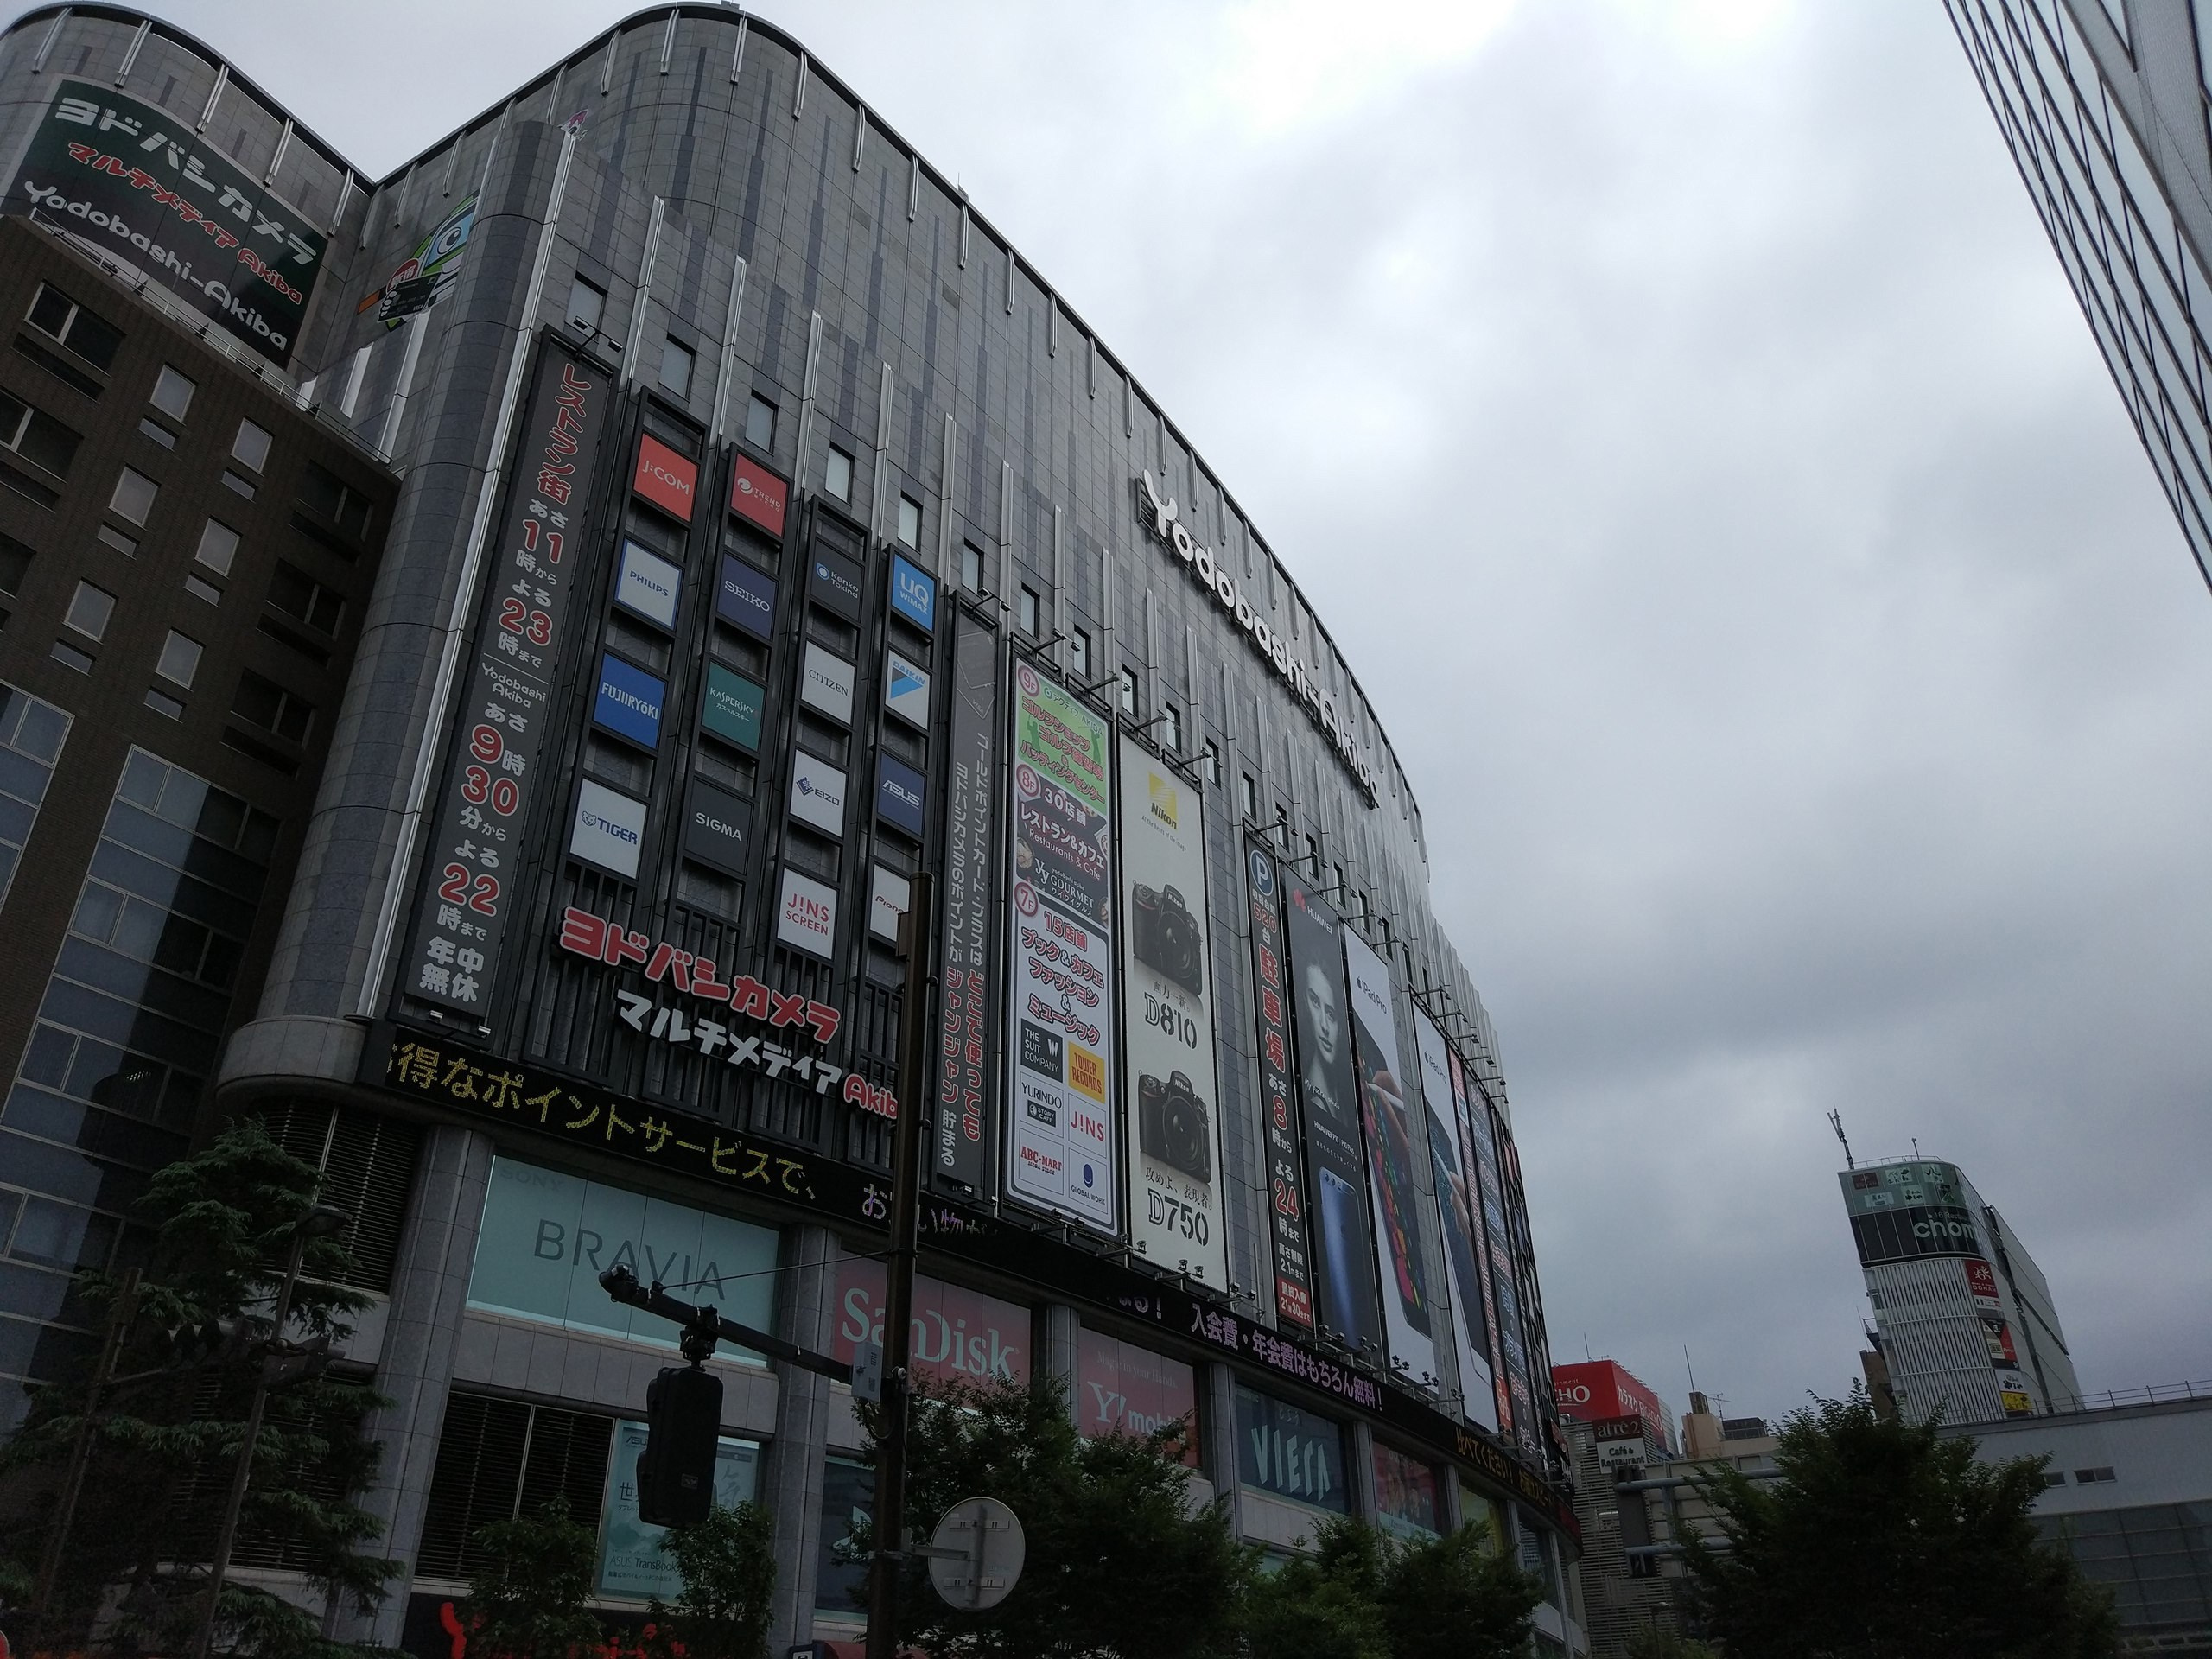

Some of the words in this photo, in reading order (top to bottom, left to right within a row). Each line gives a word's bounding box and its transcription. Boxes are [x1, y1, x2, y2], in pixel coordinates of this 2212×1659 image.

[55, 98, 316, 265] ヨドバシカメラ
[68, 142, 239, 249] マルチメディア
[238, 247, 302, 305] Akiba
[24, 180, 288, 352] Yodobashi-Akiba
[537, 363, 592, 505] レストラン街
[642, 459, 690, 496] J:COM
[754, 486, 781, 510] TREND
[529, 499, 569, 529] あさ
[522, 518, 563, 564] 11
[516, 549, 557, 585] 時から
[830, 570, 859, 594] Kenko
[512, 578, 552, 607] よる
[629, 570, 669, 598] PHILIPS
[724, 580, 770, 613] SEIKO
[830, 578, 859, 599] Tokina
[899, 572, 930, 602] UQ
[499, 597, 553, 646] 23
[498, 631, 543, 669] 時まで
[481, 662, 546, 703] Yodobashi
[809, 669, 849, 697] CITIZEN
[893, 660, 925, 686] DAIKIN
[492, 682, 531, 709] Akiba
[484, 702, 529, 733] あさ
[461, 765, 519, 817] 30
[814, 788, 840, 807] EIZO
[882, 779, 920, 807] ASUS
[459, 805, 506, 842] 分から
[696, 812, 742, 842] SIGMA
[1151, 802, 1177, 830] Nikon
[598, 817, 638, 846] TIGER
[1029, 830, 1074, 863] Restaurants
[454, 840, 499, 868] よる
[1255, 855, 1268, 887] P
[438, 862, 501, 918] 22
[875, 895, 906, 914] Pione
[1051, 875, 1095, 909] GOURMET
[1168, 893, 1183, 909] Nikon
[437, 904, 487, 942] 時まで
[785, 910, 829, 936] SCREEN
[1307, 905, 1333, 936] HUAWEI
[426, 935, 485, 975] 年中
[419, 963, 480, 1003] 無休
[559, 906, 841, 1045] ヨドバシカメラ
[1029, 957, 1100, 1007] ファッション
[1061, 995, 1071, 1013] &
[1258, 943, 1285, 1073] 駐車場
[1362, 979, 1376, 1005] iPad
[1376, 999, 1387, 1014] Pro
[1025, 1027, 1039, 1042] THE
[1027, 993, 1100, 1046] ミュージック
[1144, 991, 1198, 1050] D810
[617, 989, 842, 1094] マルチメディア
[843, 1072, 899, 1121] Akib
[1024, 1050, 1059, 1072] COMPANY
[1025, 1039, 1041, 1053] SUIT
[1074, 1052, 1097, 1072] TOWER
[1071, 1065, 1102, 1095] RECORDS
[1173, 1078, 1191, 1093] Nikon
[1268, 1072, 1287, 1097] あさ
[1022, 1082, 1062, 1109] YURINDO
[1037, 1106, 1055, 1118] STORY
[1273, 1094, 1288, 1131] 8
[1020, 1146, 1063, 1172] ABC-MART
[1275, 1158, 1294, 1182] よる
[499, 1165, 565, 1193] SONY
[1071, 1185, 1090, 1200] GLOBAL
[1090, 1192, 1106, 1206] WORK
[1274, 1177, 1300, 1223] 24
[1148, 1188, 1210, 1247] D750
[534, 1218, 726, 1300] BRAVIA
[626, 1435, 648, 1446] ASU
[1597, 1421, 1629, 1439] atré
[1630, 1420, 1640, 1436] 2
[1600, 1456, 1645, 1468] Restaurant
[1609, 1446, 1628, 1457] Café
[610, 1555, 632, 1567] ASUS
[635, 1556, 677, 1572] TransBook
